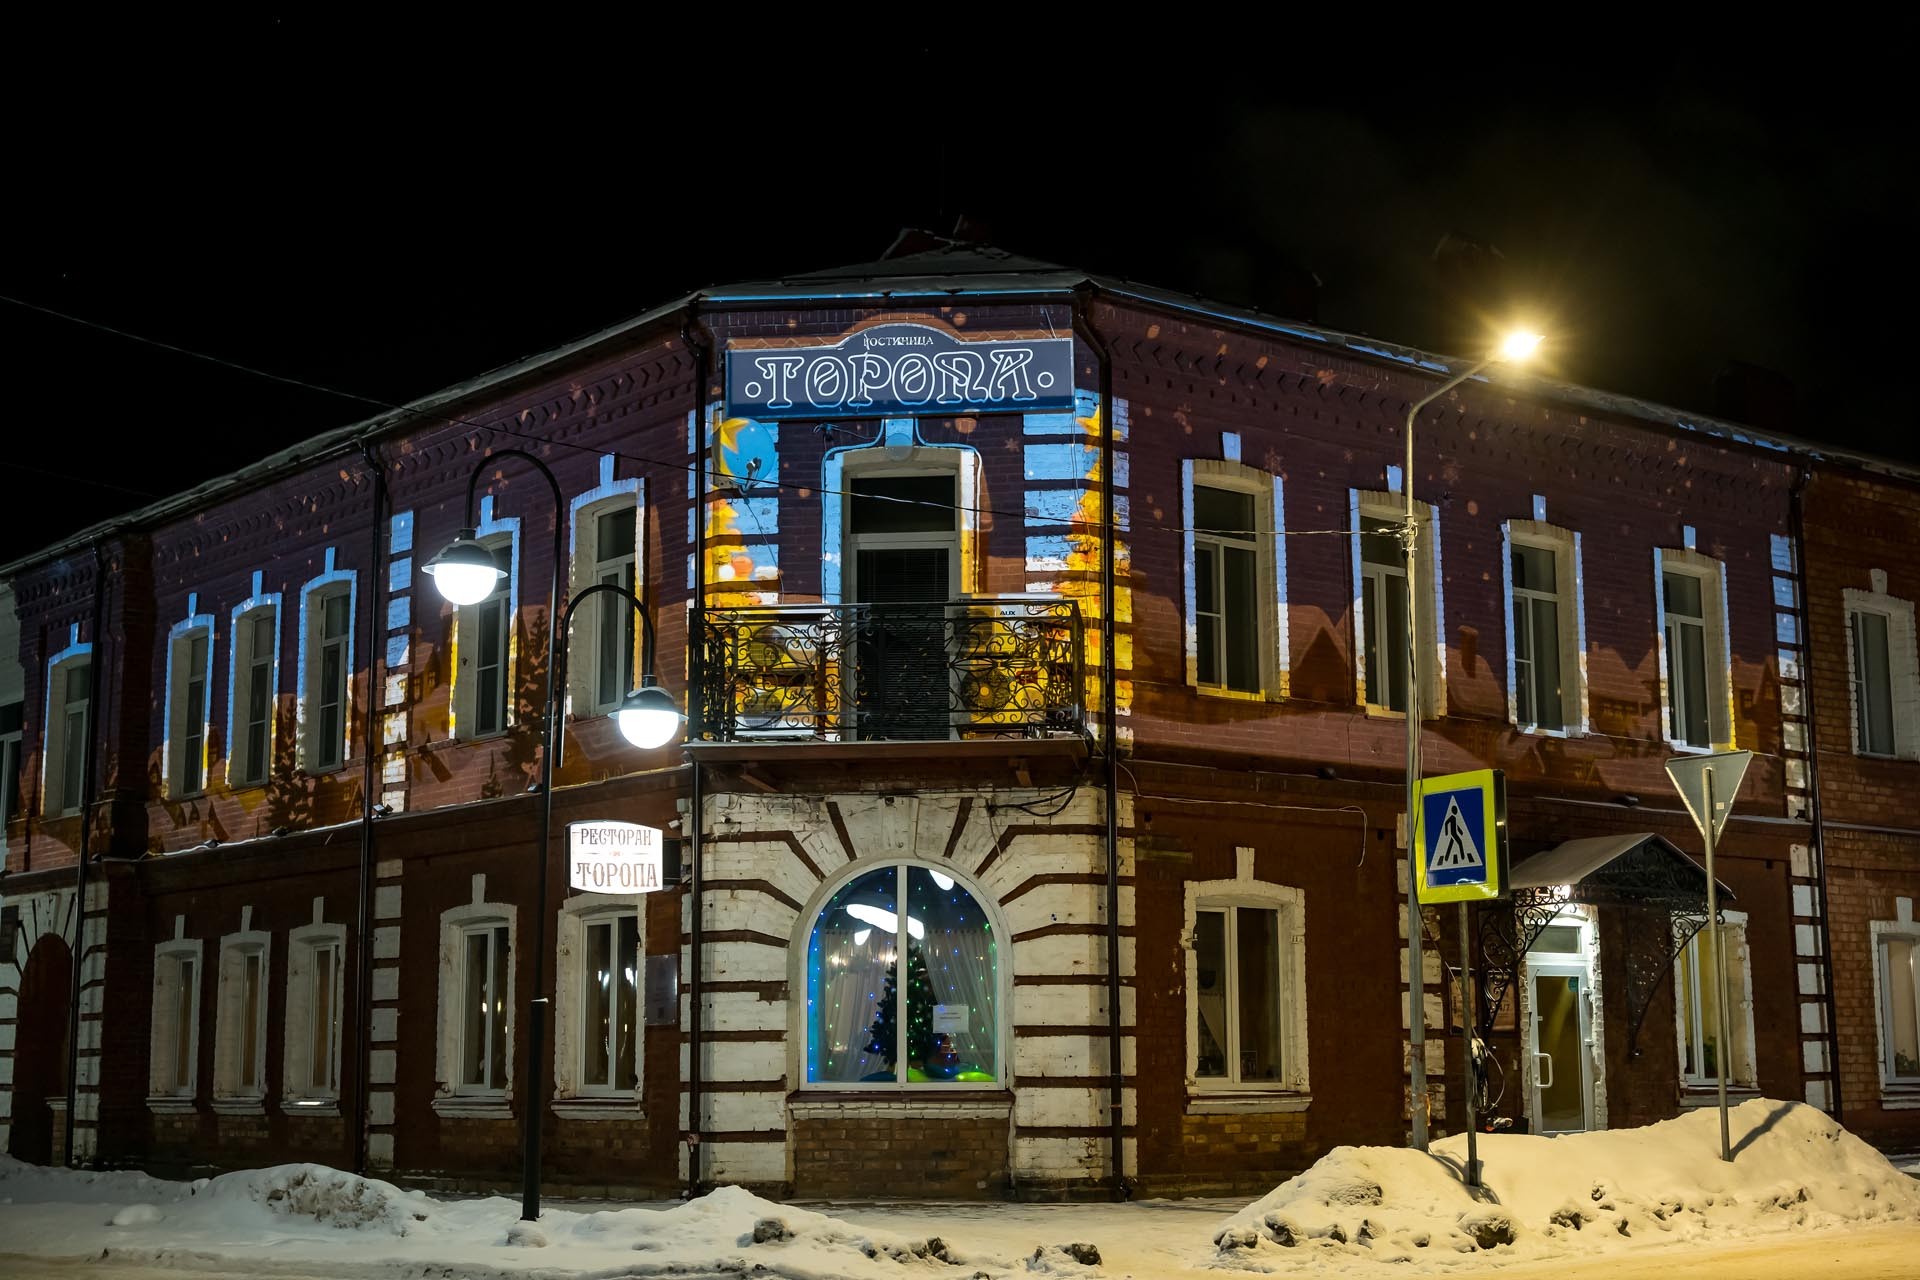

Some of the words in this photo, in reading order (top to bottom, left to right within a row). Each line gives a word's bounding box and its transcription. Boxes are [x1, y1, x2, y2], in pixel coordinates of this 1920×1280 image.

[863, 336, 934, 347] ГОСТИНИЦА
[755, 349, 1037, 409] ТОРОПА
[581, 828, 652, 846] РЕСТОРАН
[576, 862, 659, 888] ТОРОПА
